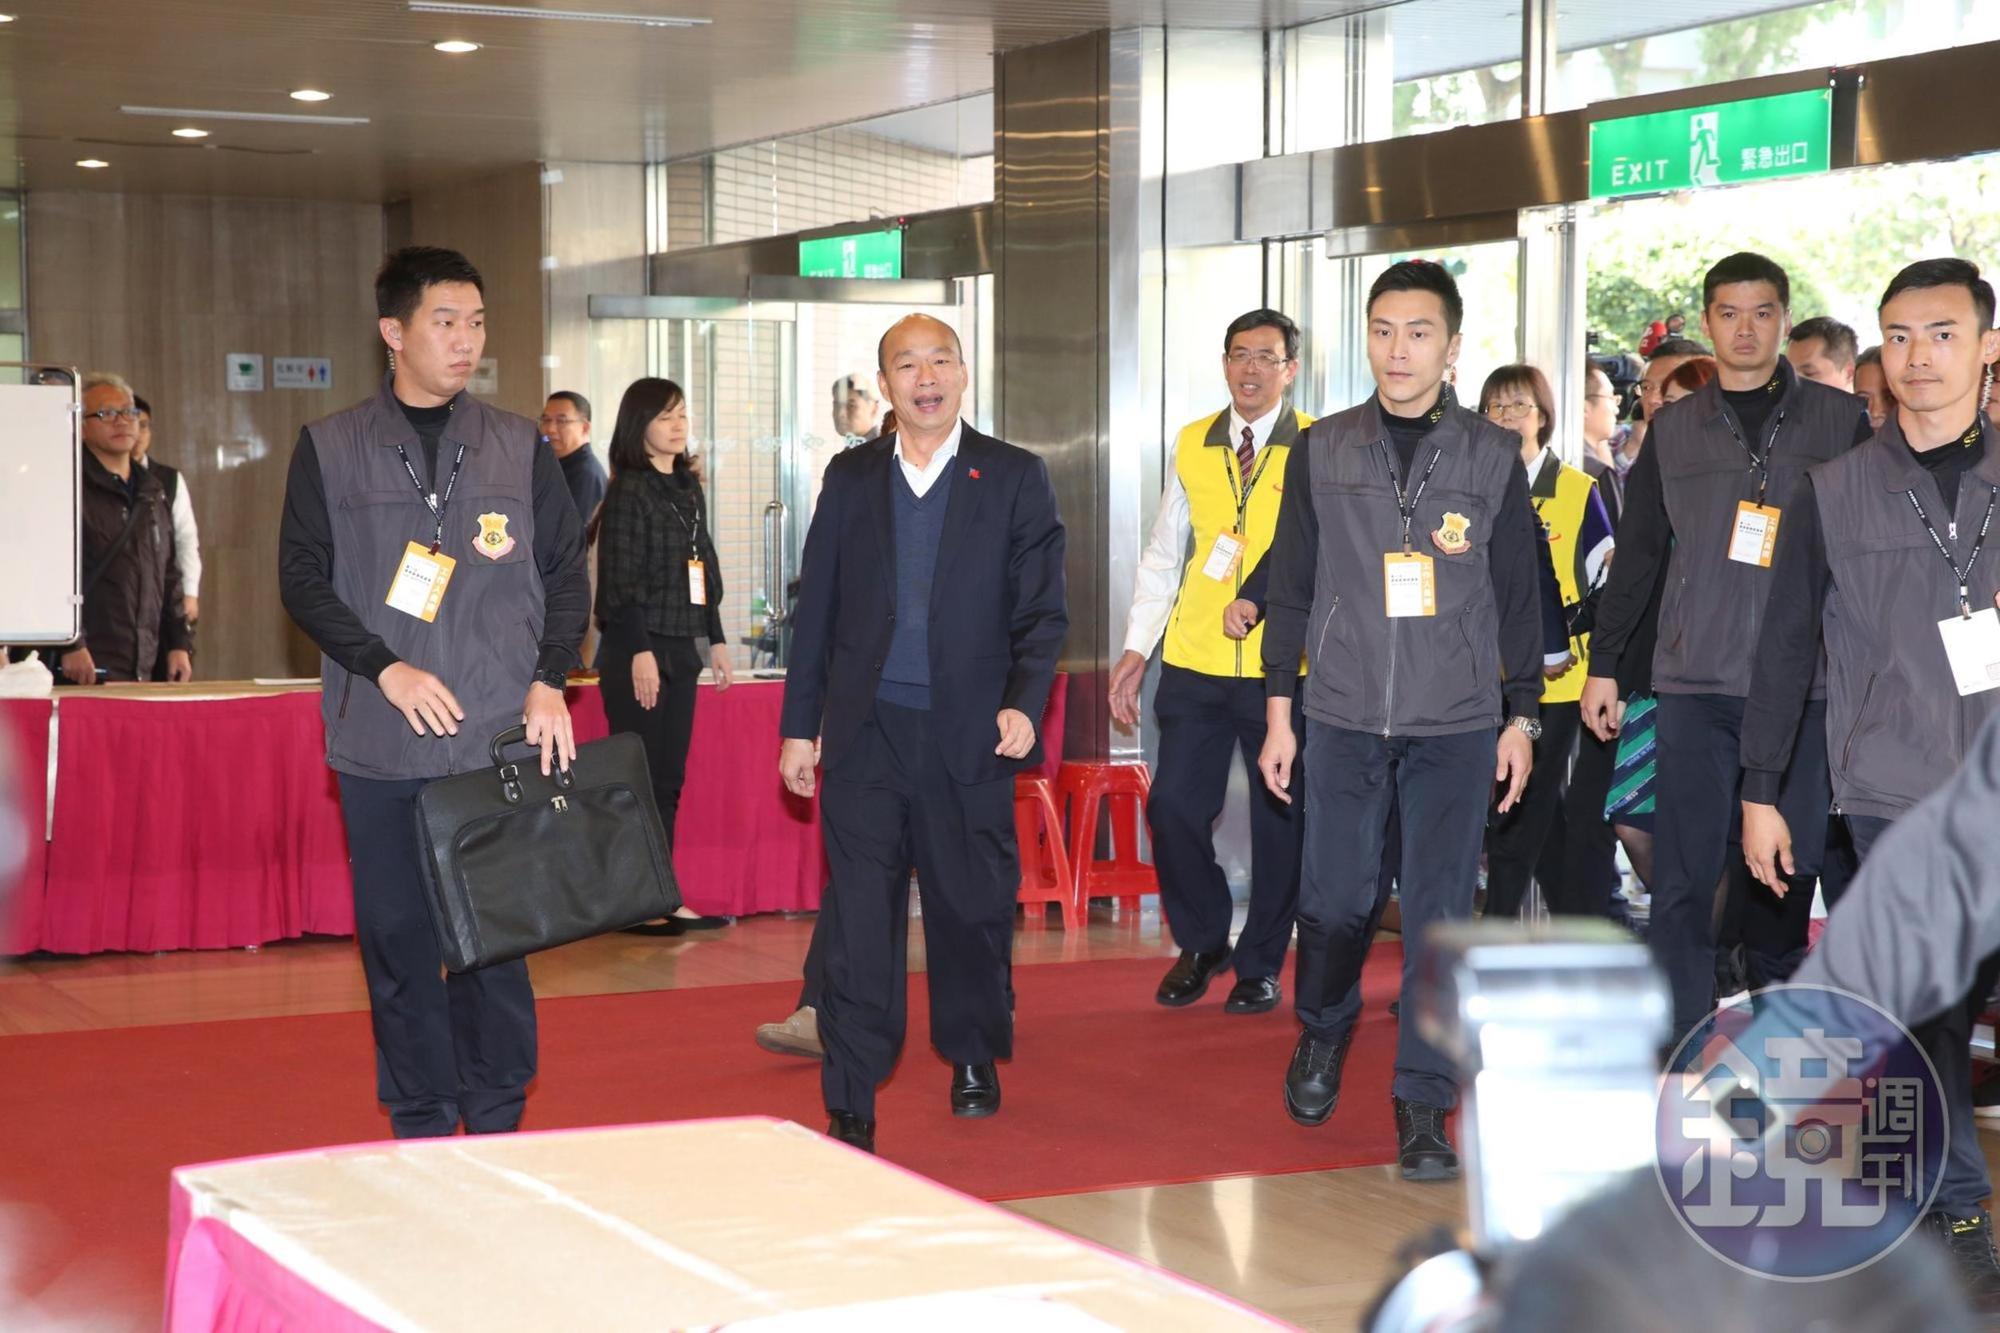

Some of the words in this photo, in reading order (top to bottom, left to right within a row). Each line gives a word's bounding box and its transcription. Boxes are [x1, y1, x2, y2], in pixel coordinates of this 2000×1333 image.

[1740, 142, 1808, 172] 緊急出口
[1611, 159, 1669, 187] EXIT
